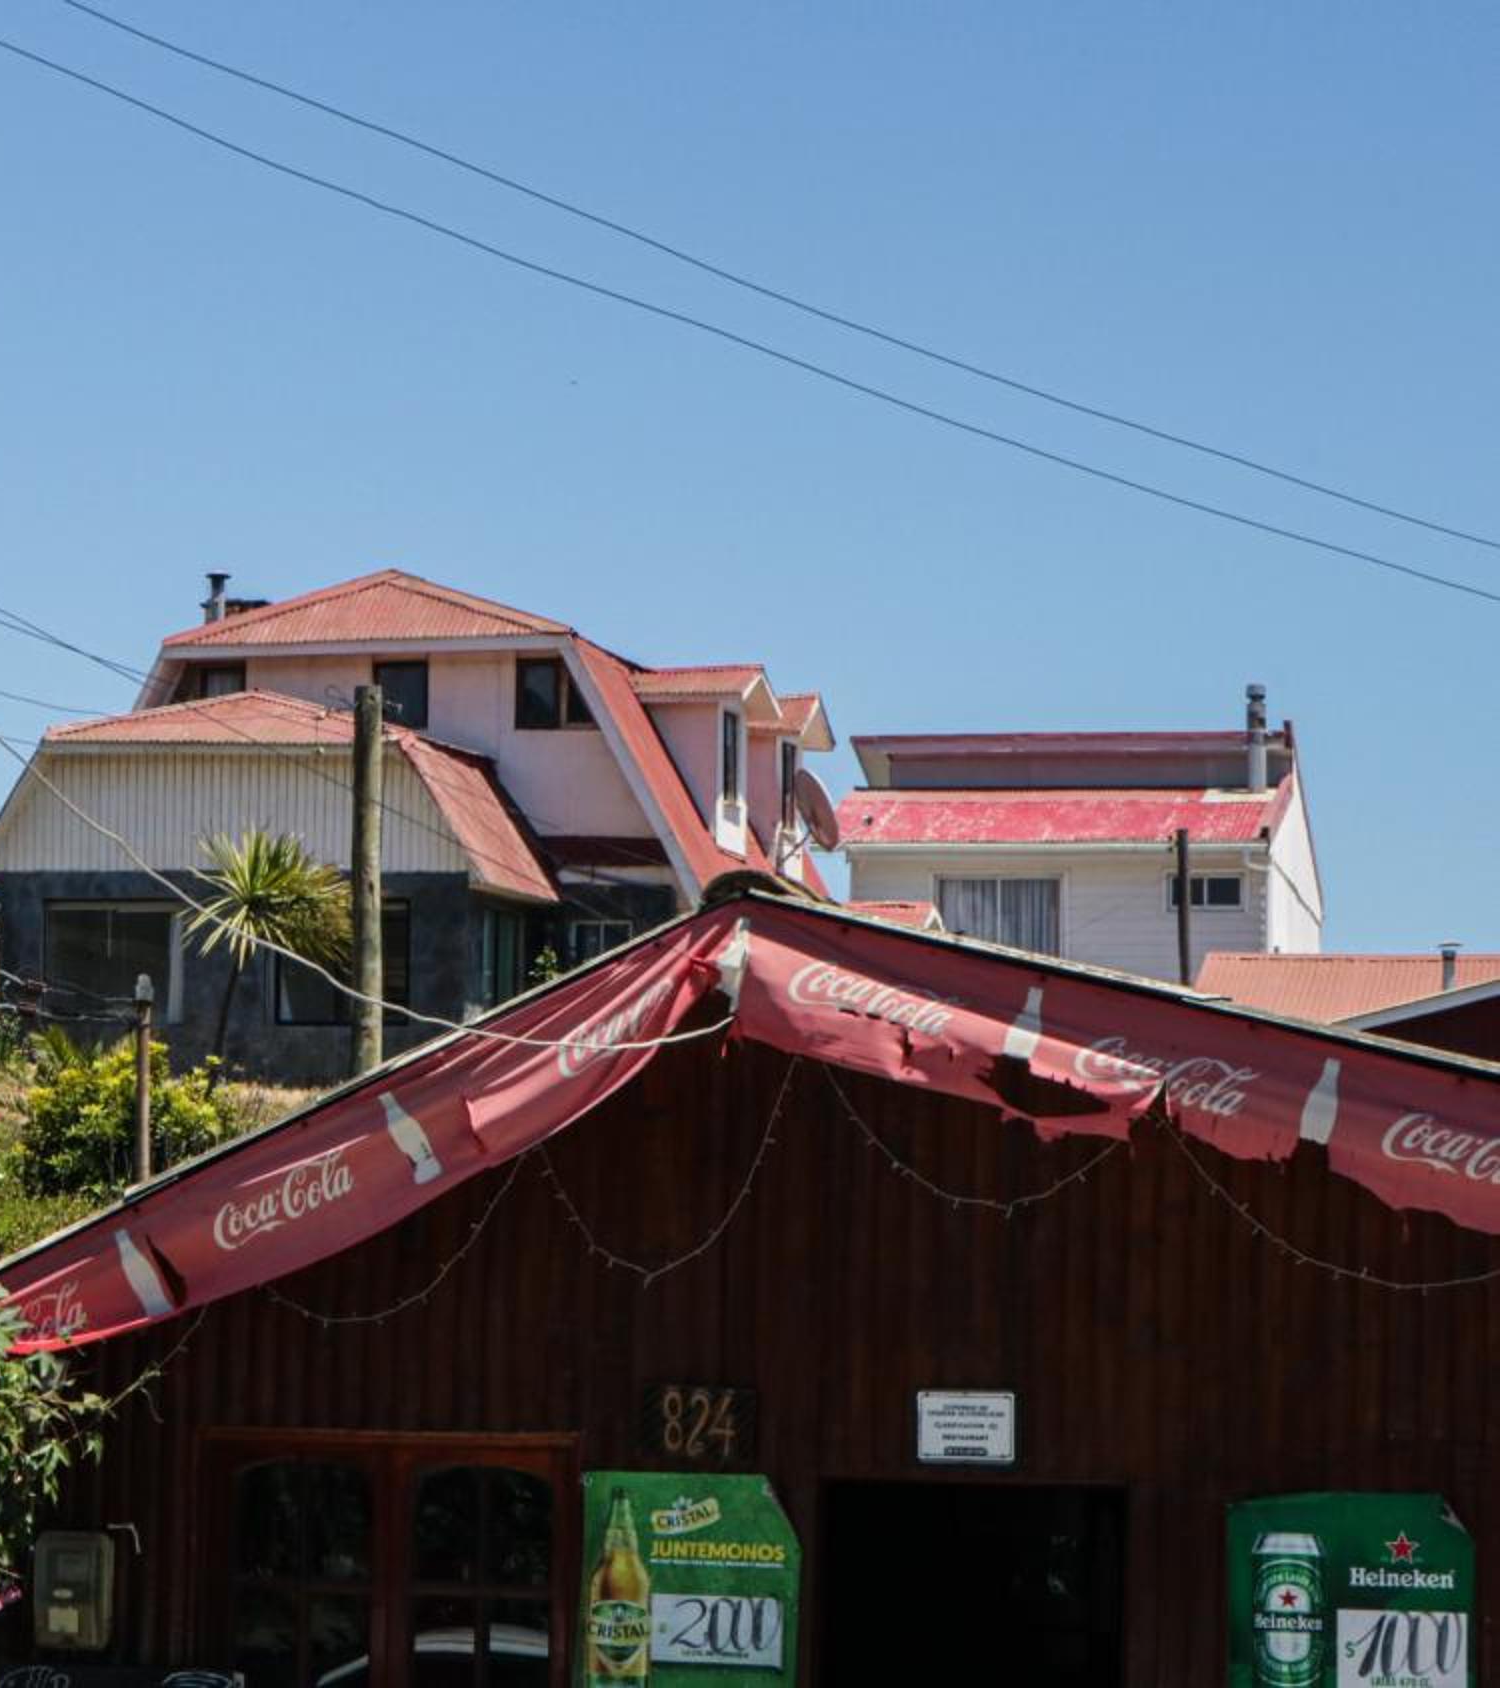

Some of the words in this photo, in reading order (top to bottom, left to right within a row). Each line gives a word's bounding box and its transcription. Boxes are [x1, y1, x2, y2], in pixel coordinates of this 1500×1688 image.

[663, 1386, 737, 1457] 824
[657, 1503, 712, 1529] CRISTAL
[650, 1539, 785, 1562] JUNTEMONOS
[1349, 1567, 1455, 1590] Heineken
